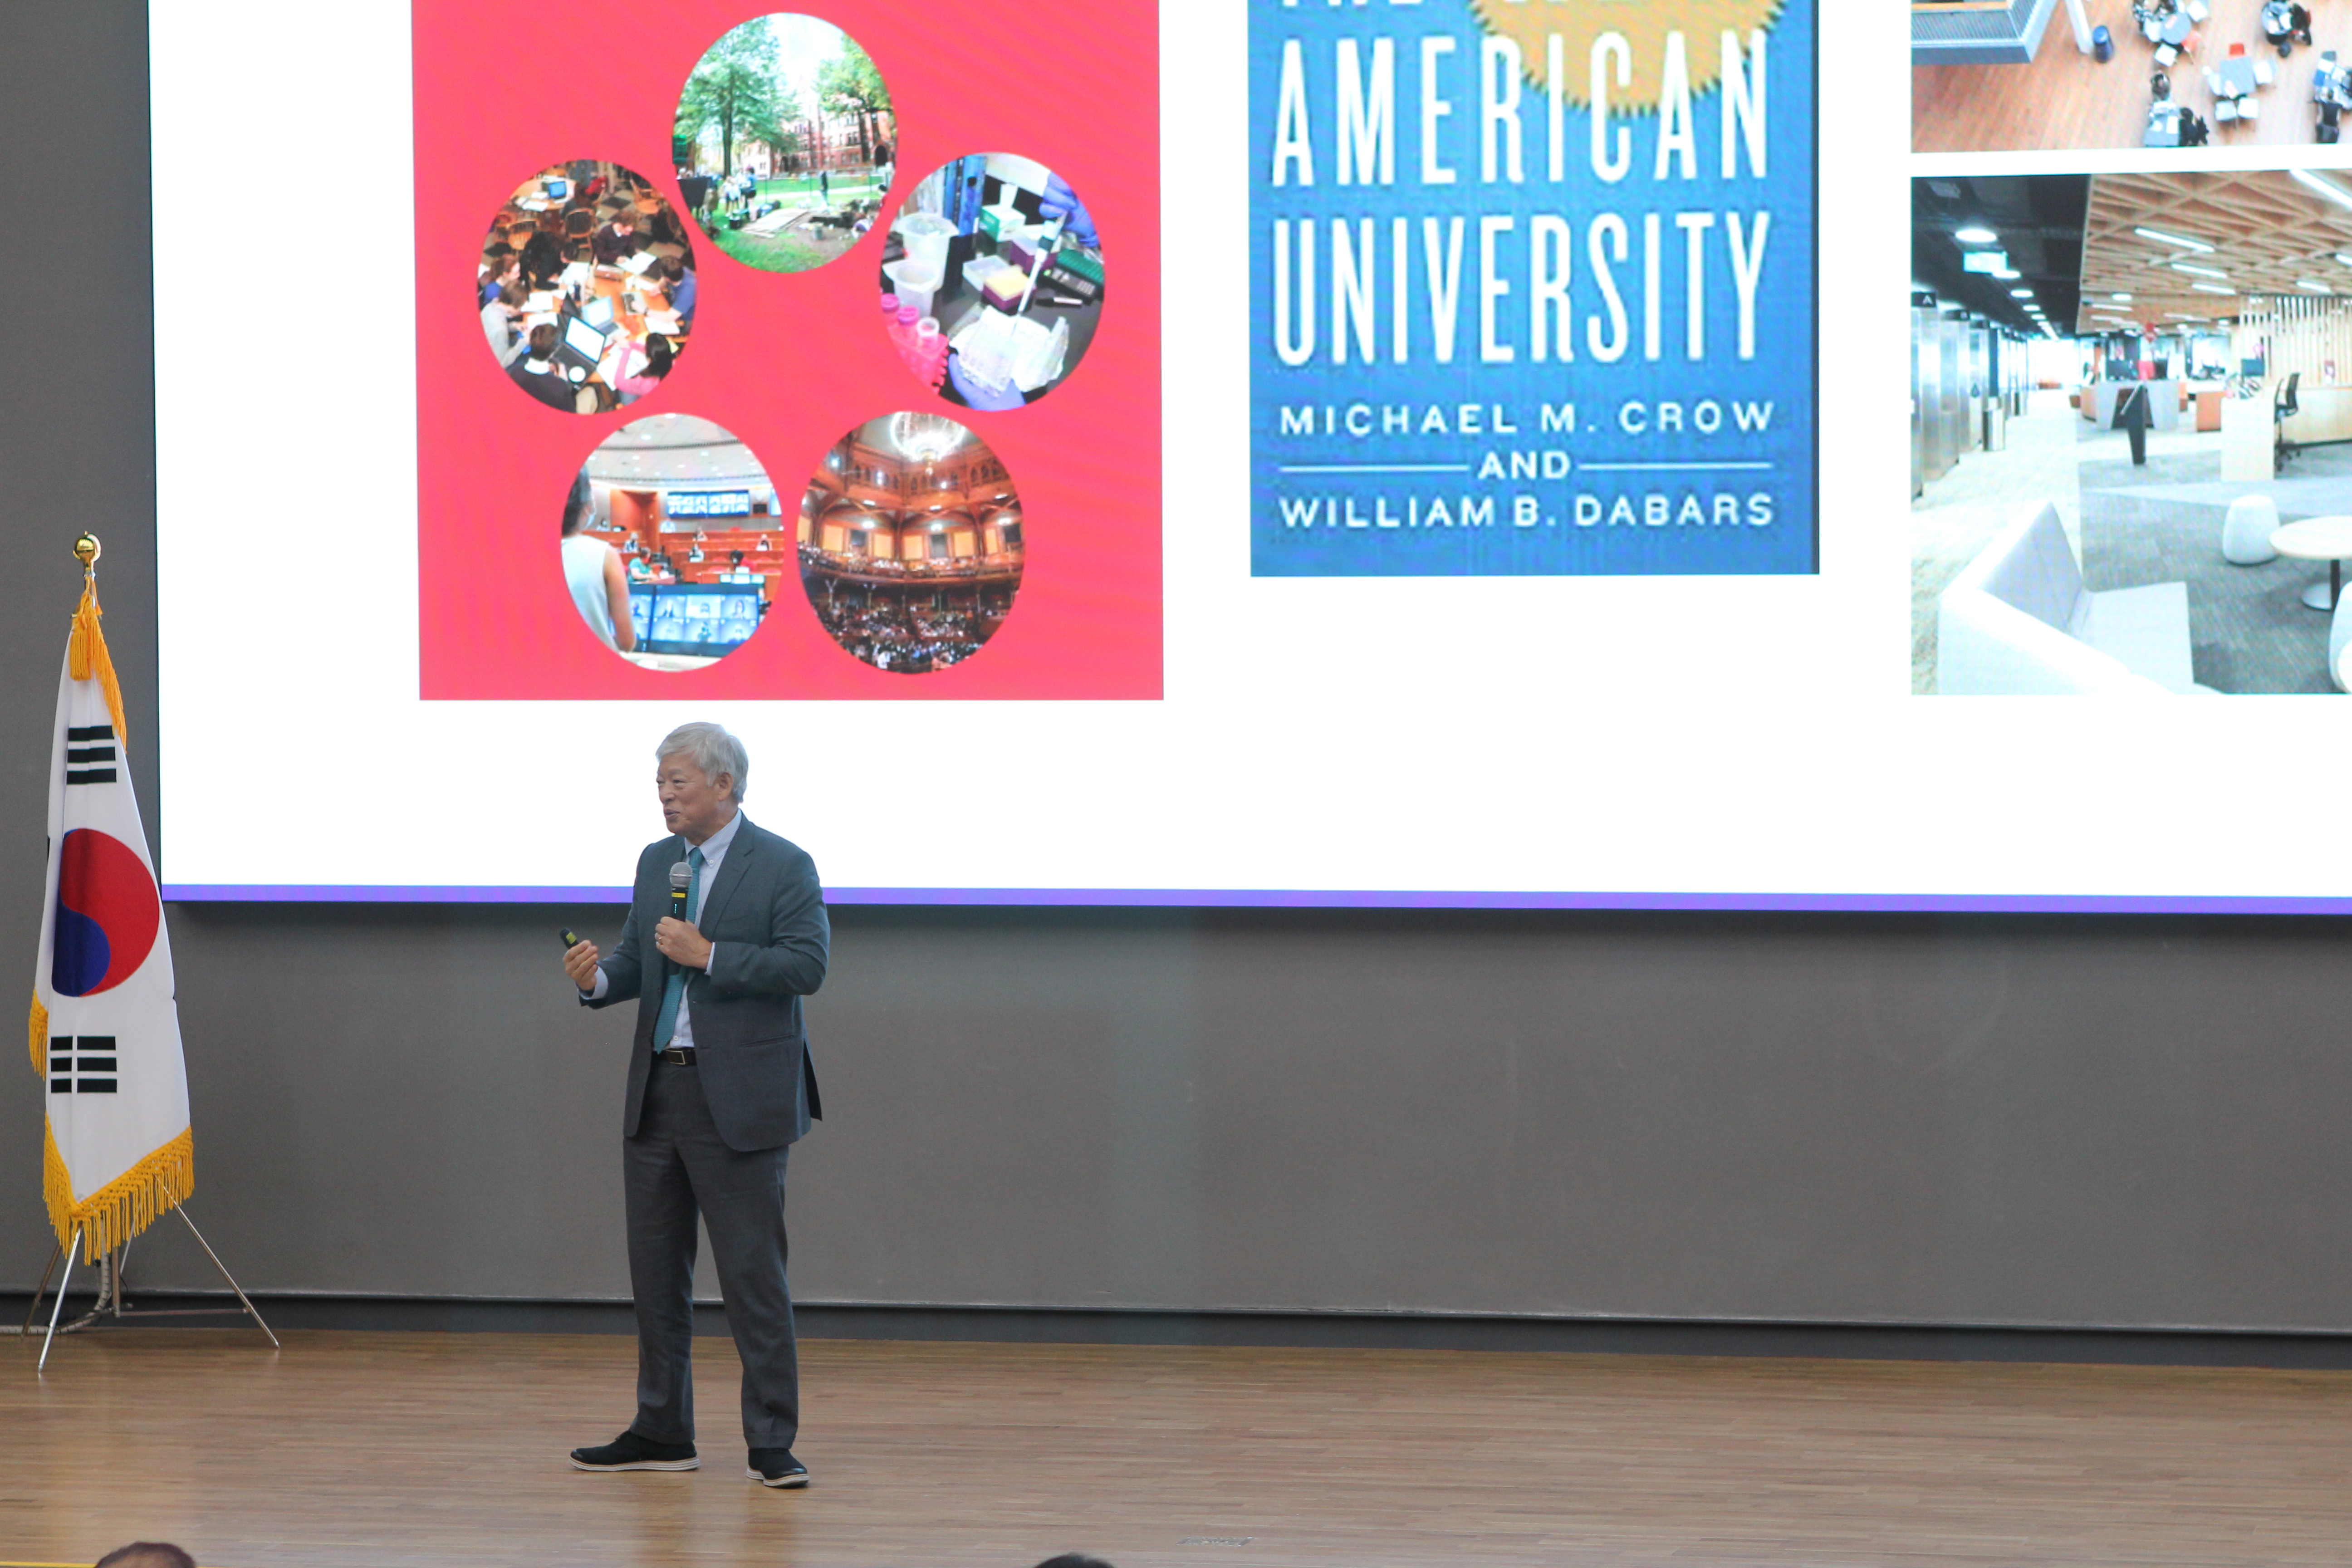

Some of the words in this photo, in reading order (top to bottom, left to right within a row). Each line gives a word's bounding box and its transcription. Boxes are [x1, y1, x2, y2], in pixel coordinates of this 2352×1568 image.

[1272, 27, 1767, 186] AMERICAN
[1274, 211, 1769, 366] UNIVERSITY
[1281, 404, 1517, 436] MICHAEL
[1541, 403, 1595, 433] M.
[1619, 401, 1773, 433] CROW
[1478, 451, 1570, 479] AND
[1280, 497, 1493, 527] WILLIAM
[1514, 496, 1555, 526] B.
[1575, 494, 1772, 526] DABARS
